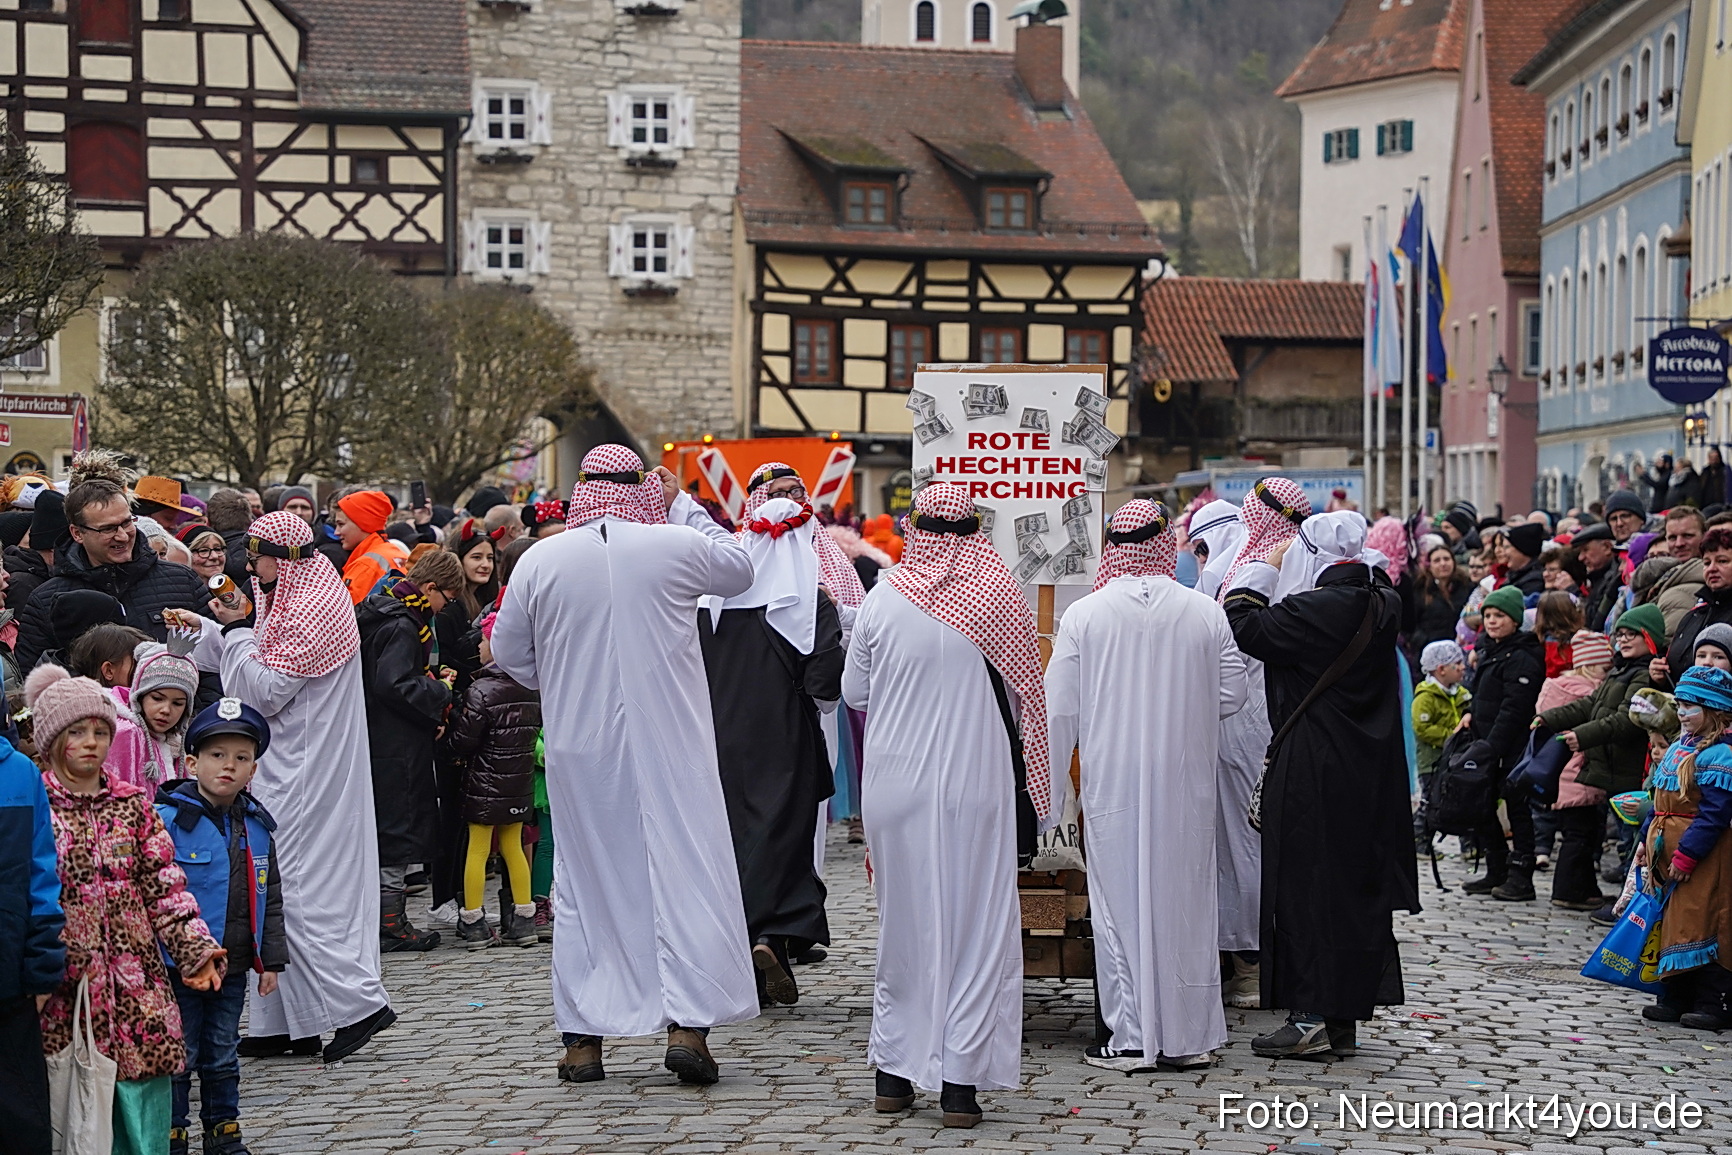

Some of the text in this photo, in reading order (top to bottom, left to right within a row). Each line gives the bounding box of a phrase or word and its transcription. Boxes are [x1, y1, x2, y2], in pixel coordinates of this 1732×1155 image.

[1655, 355, 1724, 372] METEORA
[968, 432, 1050, 450] ROTE
[936, 457, 1081, 474] HECHTEN
[928, 481, 1087, 499] RCHING
[1042, 823, 1078, 848] TAR
